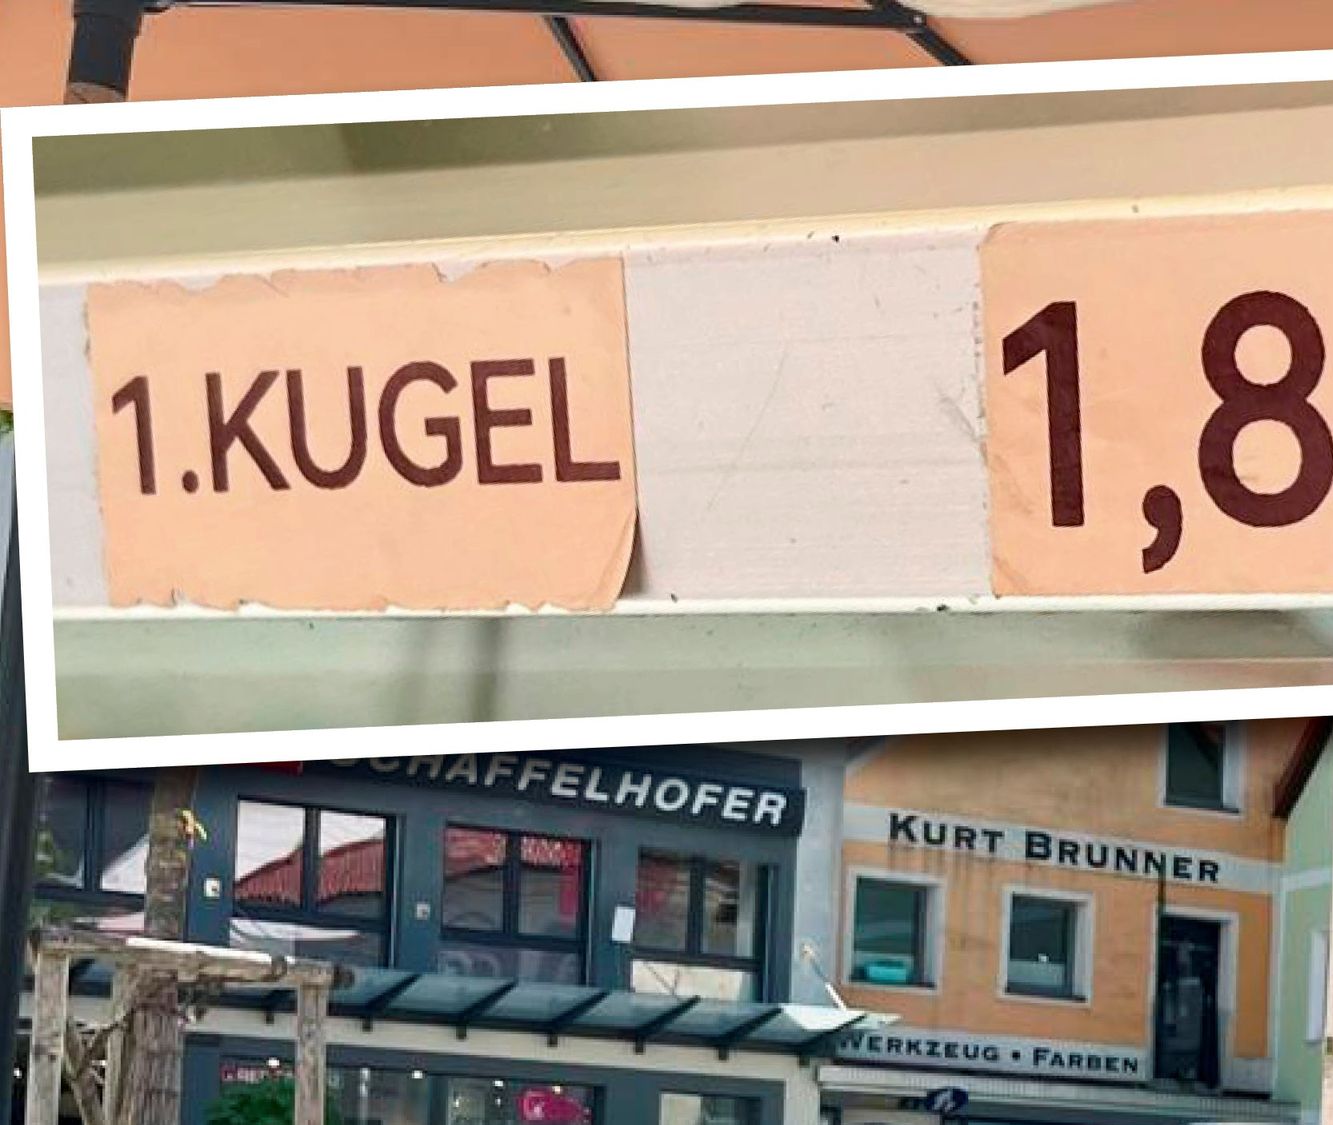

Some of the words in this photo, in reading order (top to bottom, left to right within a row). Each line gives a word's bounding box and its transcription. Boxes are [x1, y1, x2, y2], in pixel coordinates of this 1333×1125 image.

[111, 356, 622, 496] 1.KUGEL
[331, 752, 788, 826] HAFFELHOFER
[888, 811, 1005, 854] KURT
[1023, 829, 1220, 884] BRUNNER
[1032, 1046, 1139, 1074] FARBEN
